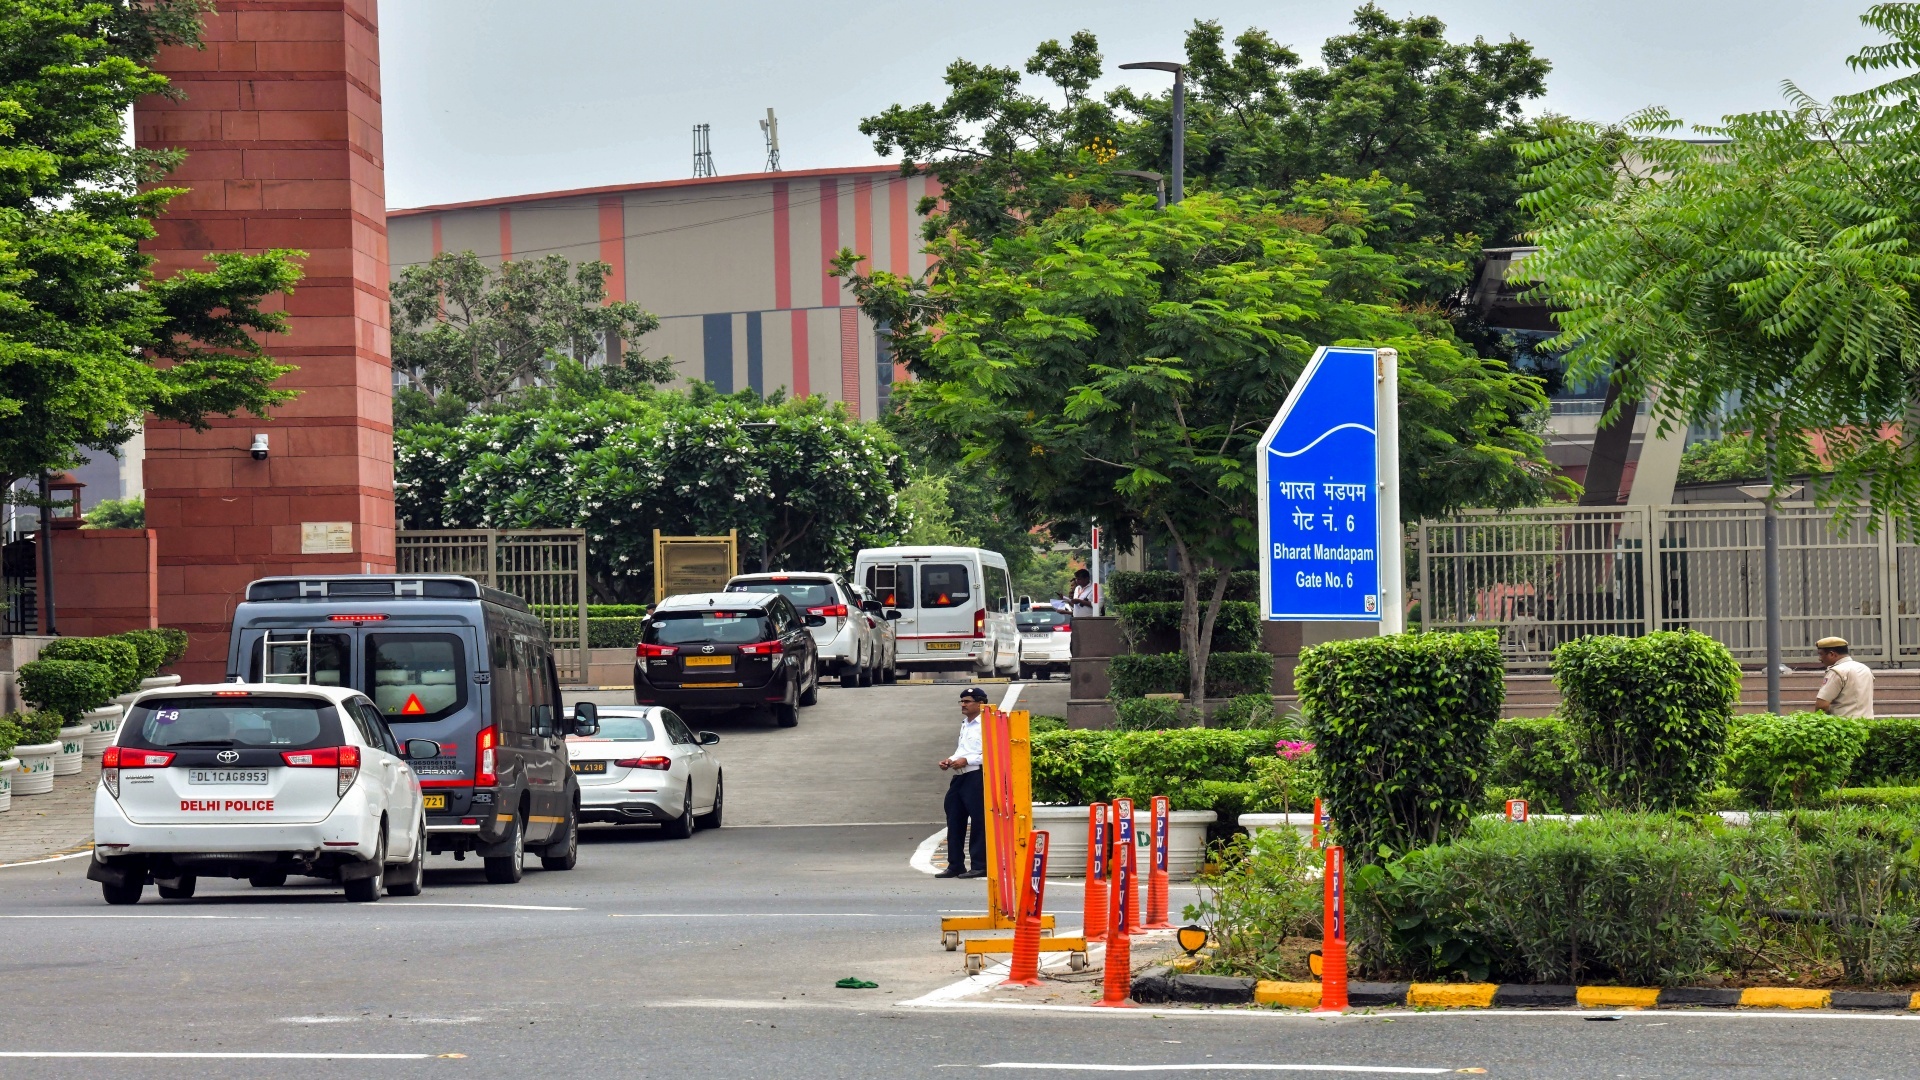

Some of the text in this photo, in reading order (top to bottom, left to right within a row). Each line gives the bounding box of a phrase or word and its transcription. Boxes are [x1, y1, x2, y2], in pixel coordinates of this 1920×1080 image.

[1279, 475, 1367, 502] भारत मंडपम
[1291, 505, 1355, 532] गेट नं. 6
[1273, 543, 1374, 565] Bharat Mandapam
[1295, 571, 1354, 588] Gate No. 6
[155, 710, 179, 721] F-8
[584, 763, 604, 771] 4138
[197, 771, 267, 782] DL1CAG8953
[180, 800, 275, 812] DELHI POLICE
[423, 797, 443, 806] 721
[1094, 826, 1103, 874] PWD
[1156, 819, 1165, 865] PWD
